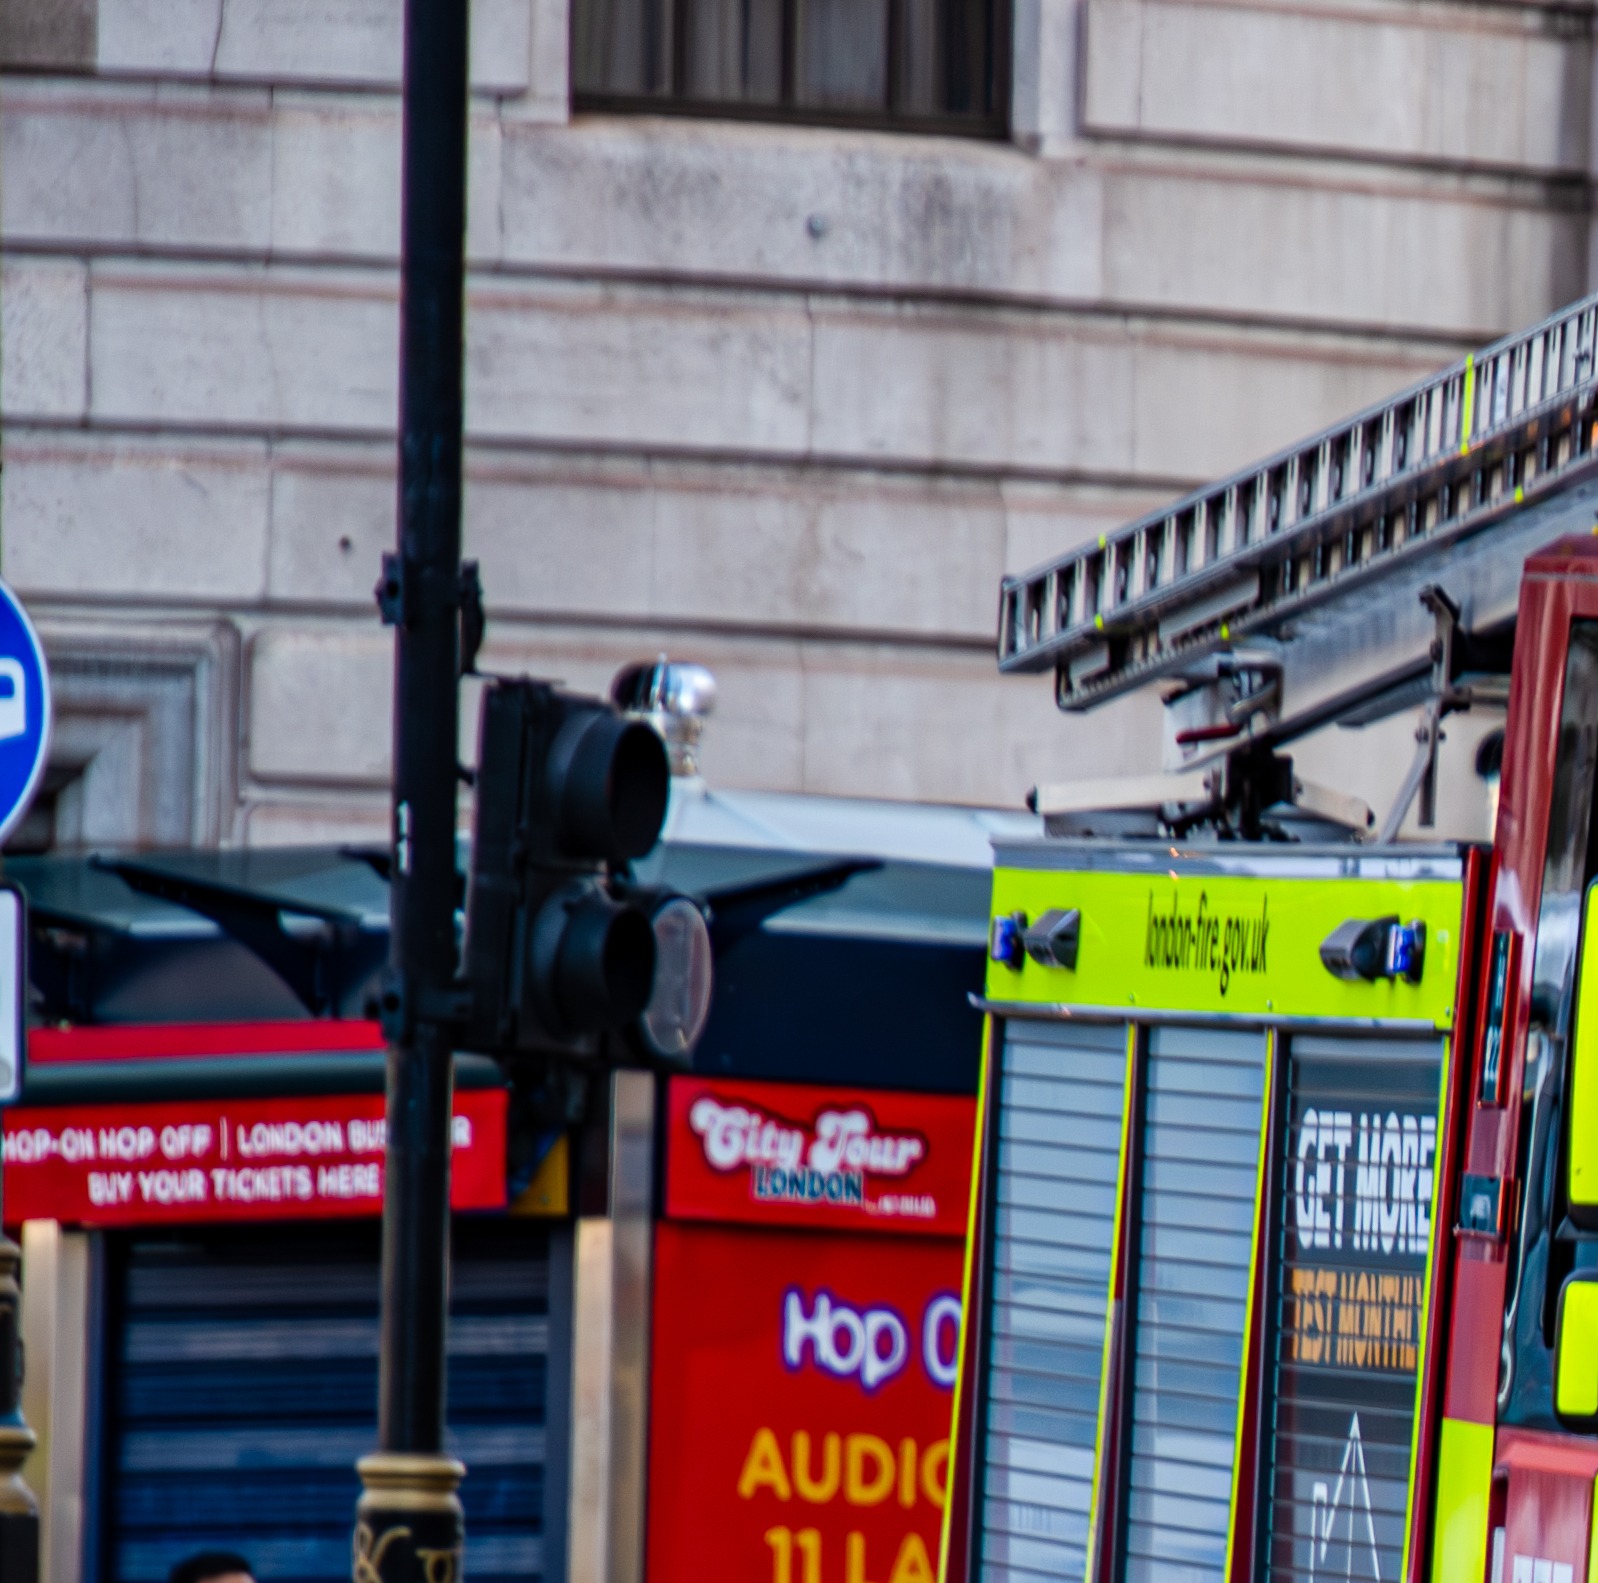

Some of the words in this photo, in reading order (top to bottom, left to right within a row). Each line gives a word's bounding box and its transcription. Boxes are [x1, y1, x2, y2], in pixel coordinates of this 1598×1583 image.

[1144, 888, 1269, 998] london-fire.gov.uk
[98, 1126, 156, 1161] HOP
[160, 1123, 213, 1160] OFF
[236, 1121, 343, 1158] LONDON
[689, 1097, 804, 1169] City
[809, 1110, 923, 1173] Tour
[87, 1171, 134, 1206] BUY
[137, 1168, 206, 1204] YOUR
[209, 1165, 314, 1203] TICKETS
[316, 1162, 380, 1198] HERE
[753, 1165, 864, 1205] LONDON
[1295, 1108, 1352, 1250] GET
[1353, 1111, 1436, 1255] MORE
[783, 1290, 907, 1389] Hop
[1292, 1269, 1338, 1366] TEST
